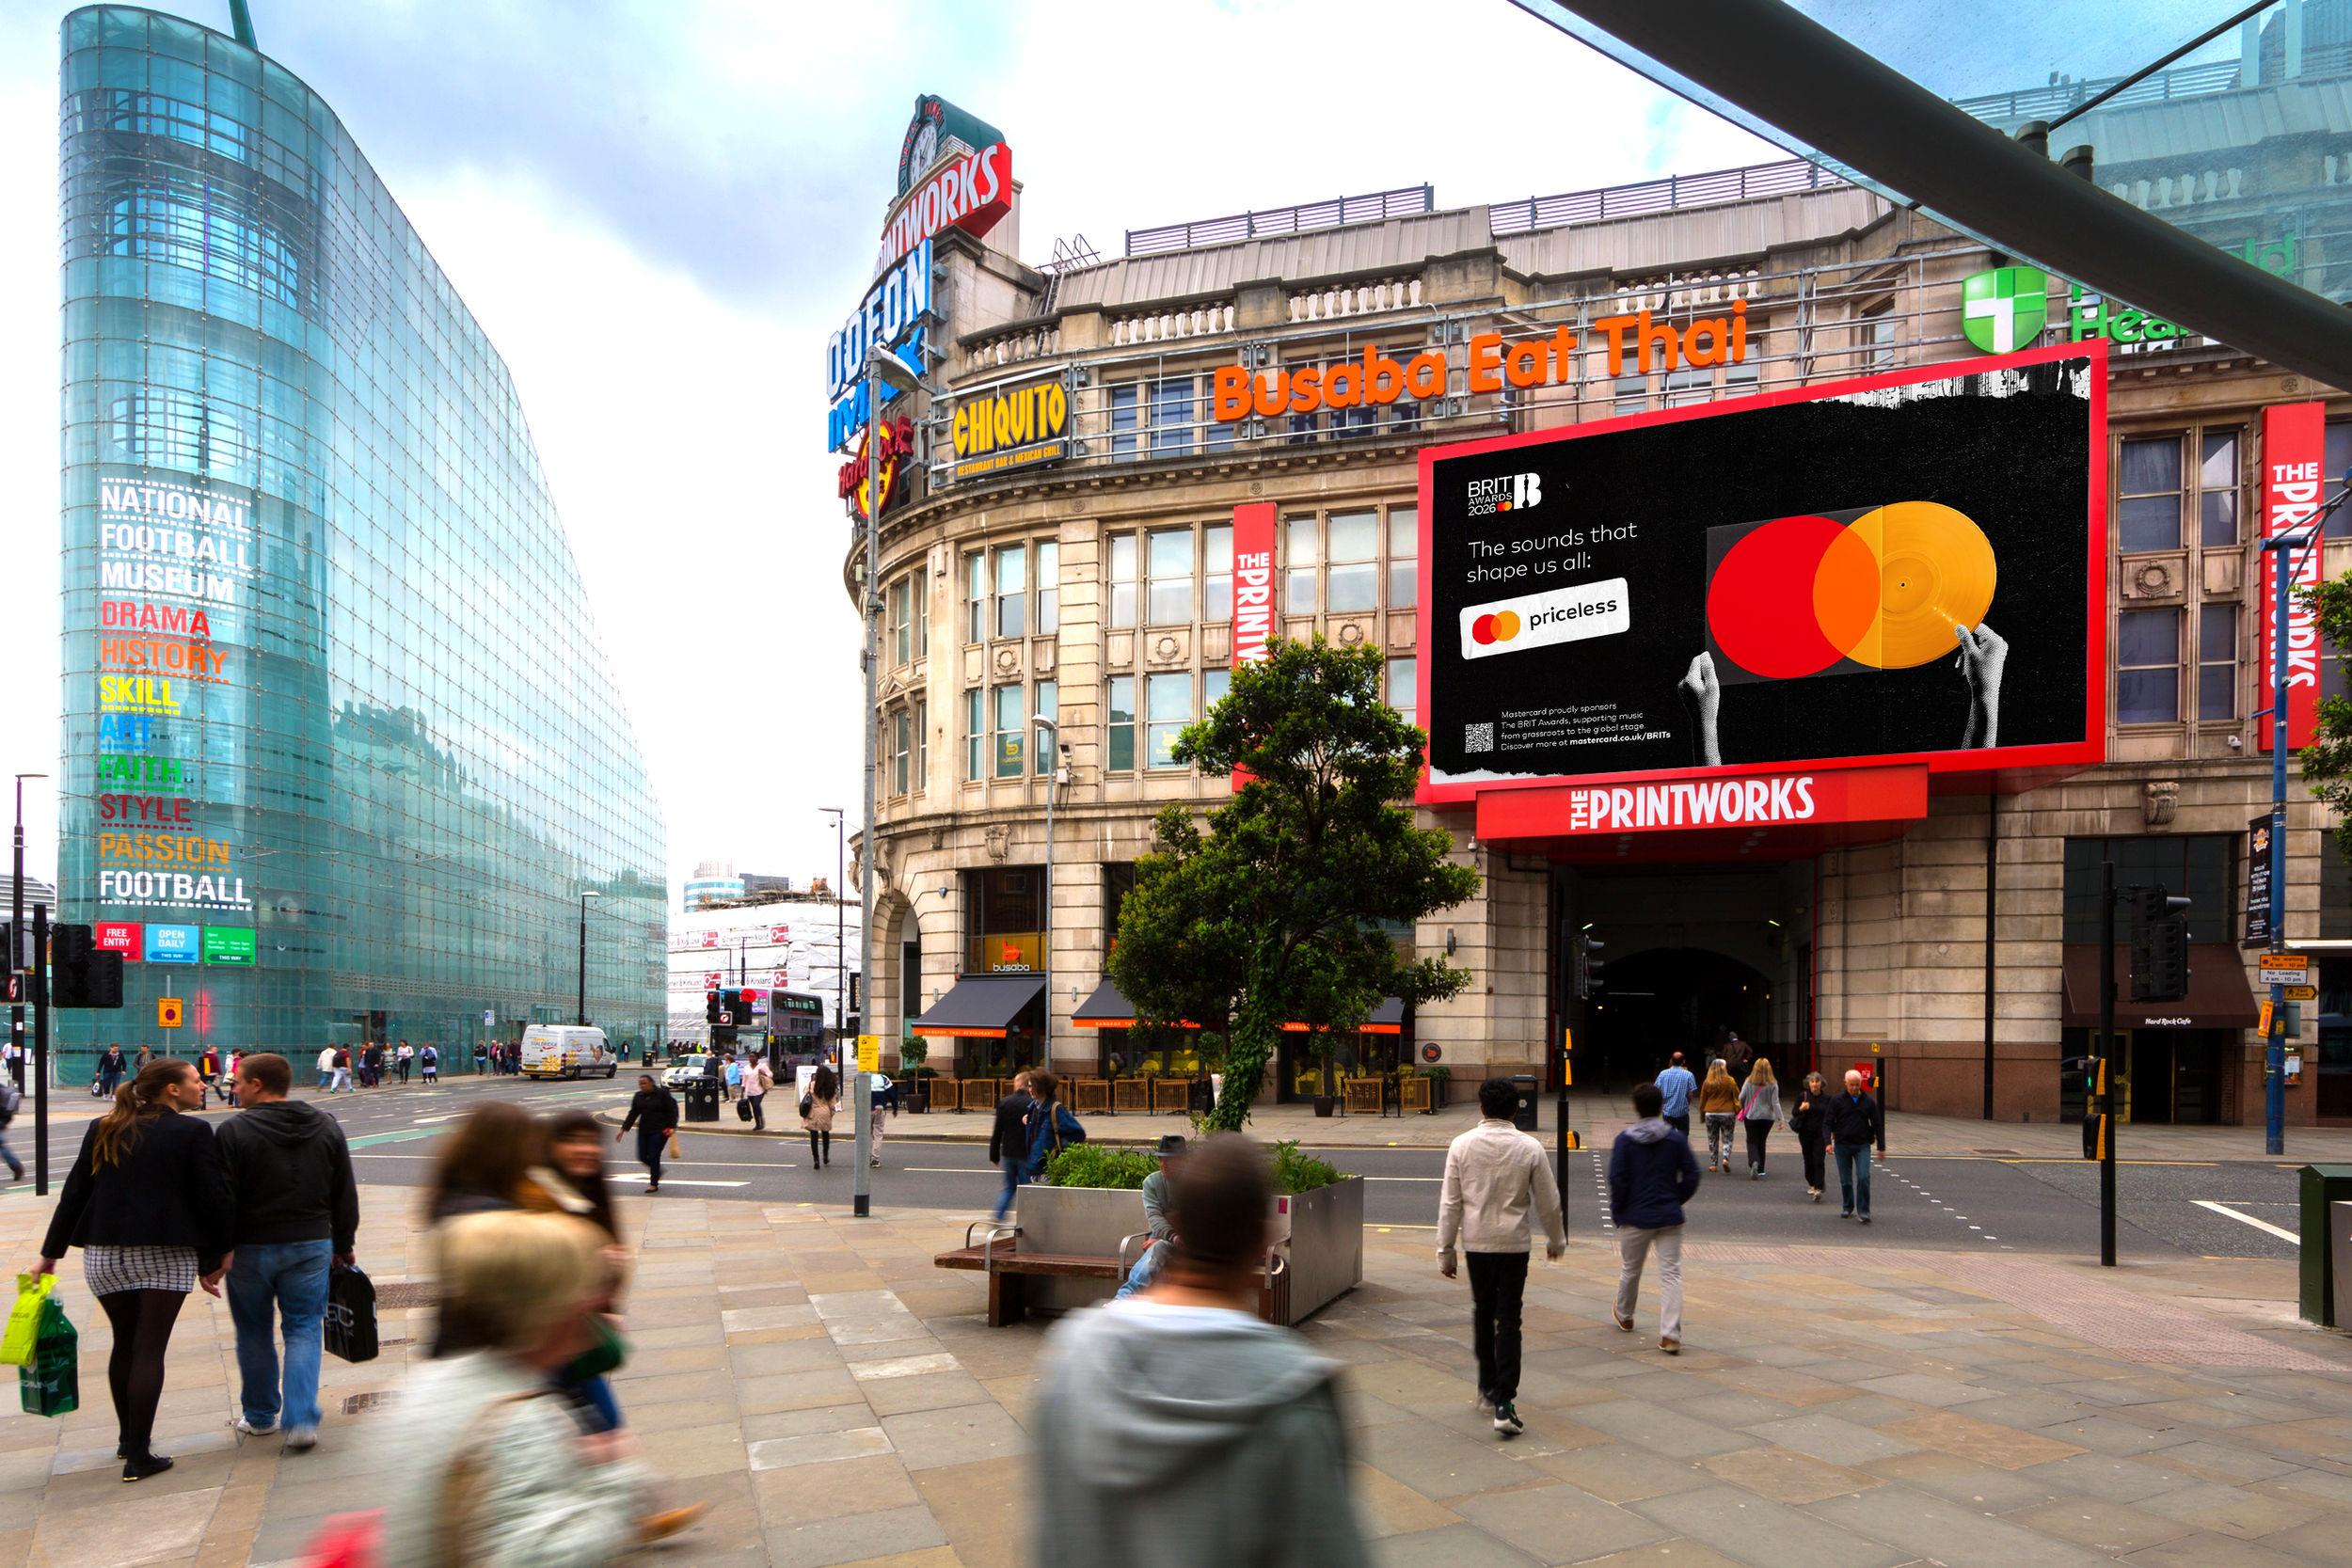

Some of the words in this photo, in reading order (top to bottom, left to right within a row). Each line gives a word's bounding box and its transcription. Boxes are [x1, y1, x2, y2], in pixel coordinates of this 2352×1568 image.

[826, 237, 930, 399] ODEON
[1214, 344, 1446, 421] Busaba
[1470, 325, 1578, 392] Eat
[1595, 299, 1748, 377] Thai
[952, 382, 1066, 456] CHIQUITO
[957, 459, 994, 477] RESTAURANT
[995, 456, 1008, 468] BAR
[1009, 455, 1014, 466] &
[1015, 448, 1042, 464] MEXICAN
[1043, 444, 1061, 458] GRILL
[2272, 462, 2318, 482] THE
[1468, 476, 1512, 498] BRIT
[1468, 492, 1513, 506] AWARDS
[102, 485, 251, 534] NATIONAL
[1468, 503, 1496, 516] 2026
[102, 524, 253, 571] FOOTBALL
[1468, 540, 1505, 559] The
[1511, 529, 1584, 554] sounds
[1590, 522, 1638, 543] that
[1237, 552, 1270, 569] THE
[1467, 564, 1528, 583] shape
[1534, 561, 1557, 575] us
[1563, 551, 1592, 571] all:
[102, 562, 233, 603] MUSEUM
[102, 600, 211, 637] DRAMA
[1530, 599, 1617, 631] priceless
[102, 638, 229, 674] HISTORY
[101, 675, 180, 707] SKILL
[1502, 707, 1547, 719] Mastercard
[1549, 705, 1579, 716] proudly
[1581, 704, 1616, 713] sponsors
[1518, 720, 1535, 728] BRIT
[1538, 717, 1571, 727] Awards,
[1572, 714, 1617, 724] supporting
[1619, 711, 1643, 720] music
[100, 715, 154, 742] ART
[1501, 732, 1520, 740] from
[1522, 729, 1565, 739] grassroots
[1593, 724, 1618, 735] global
[1620, 722, 1646, 732] stage.
[1501, 742, 1534, 751] Discover
[1569, 731, 1671, 746] mastercard.co.uk/BRITs
[100, 754, 182, 784] FAITH
[100, 793, 191, 823] STYLE
[1570, 790, 1588, 830] THE
[1590, 777, 1815, 830] PRINTWORKS
[101, 833, 230, 864] PASSION
[101, 871, 251, 903] FOOTBALL
[103, 938, 131, 946] ENTRY
[106, 928, 127, 937] FREE
[158, 940, 185, 948] DAILY
[159, 929, 185, 939] OPEN
[993, 962, 1030, 972] busaba
[2161, 1018, 2176, 1026] Rock
